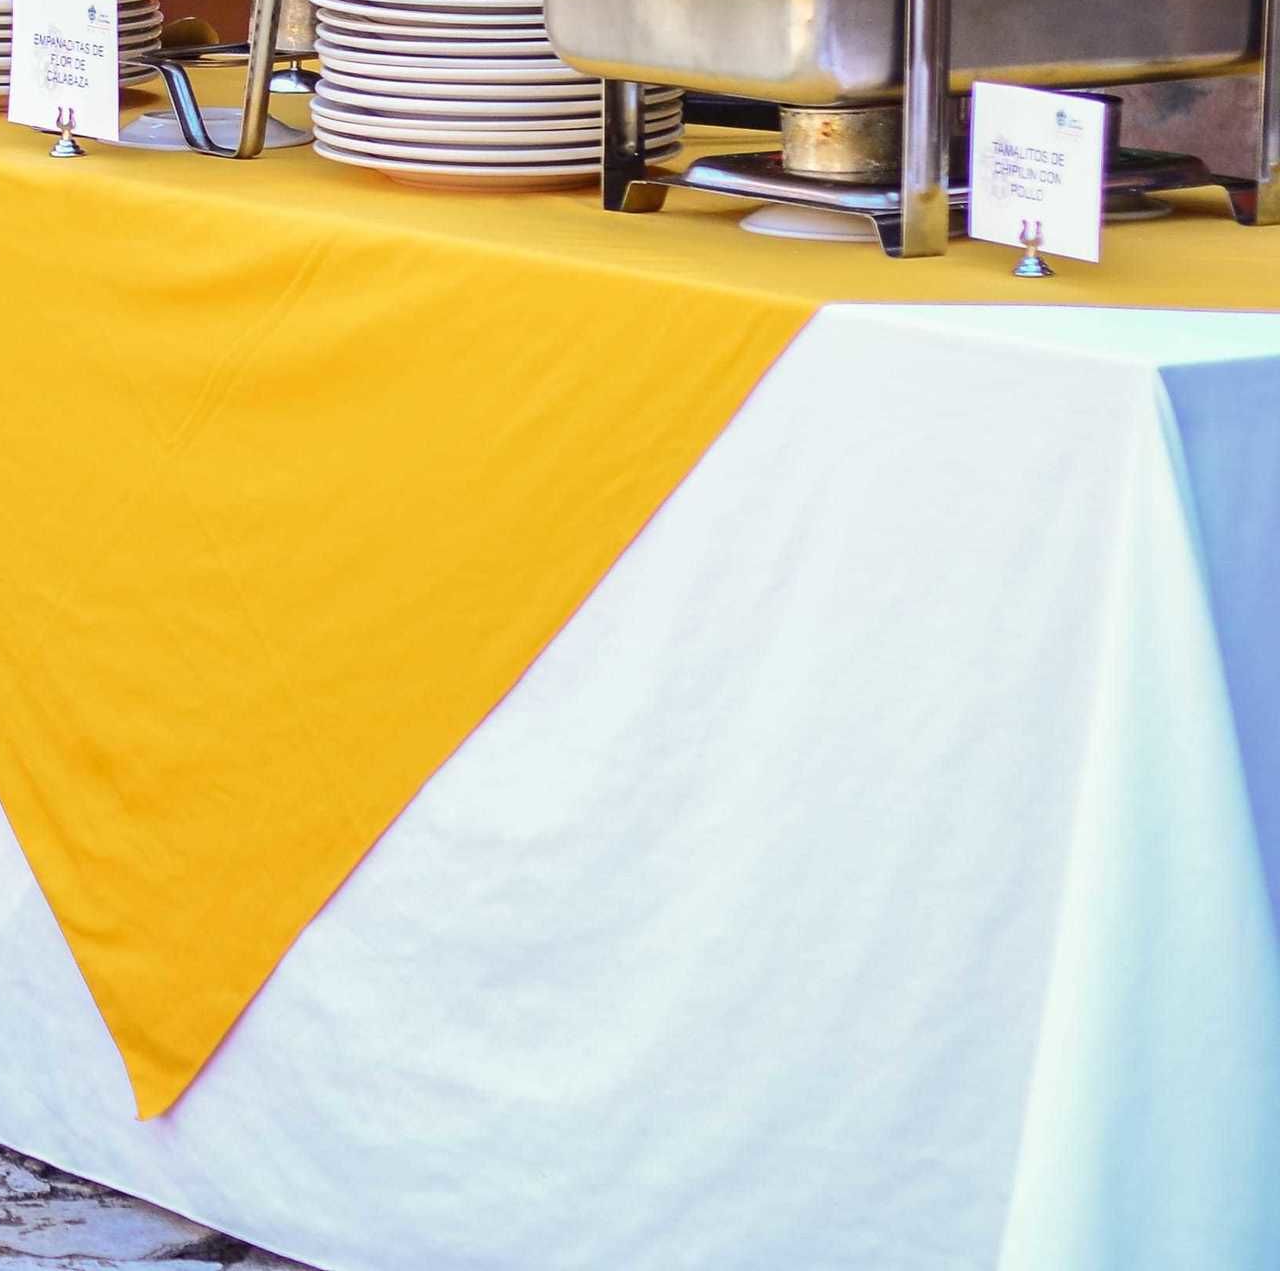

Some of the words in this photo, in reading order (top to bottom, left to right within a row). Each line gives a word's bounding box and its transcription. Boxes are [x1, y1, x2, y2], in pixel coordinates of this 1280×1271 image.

[33, 33, 90, 54] EMPANADITAS
[92, 44, 104, 57] DE
[51, 53, 72, 67] FLOR
[75, 58, 86, 71] DE
[47, 70, 89, 88] CALABAZA
[1051, 152, 1065, 167] DE
[1011, 183, 1042, 201] POLLO
